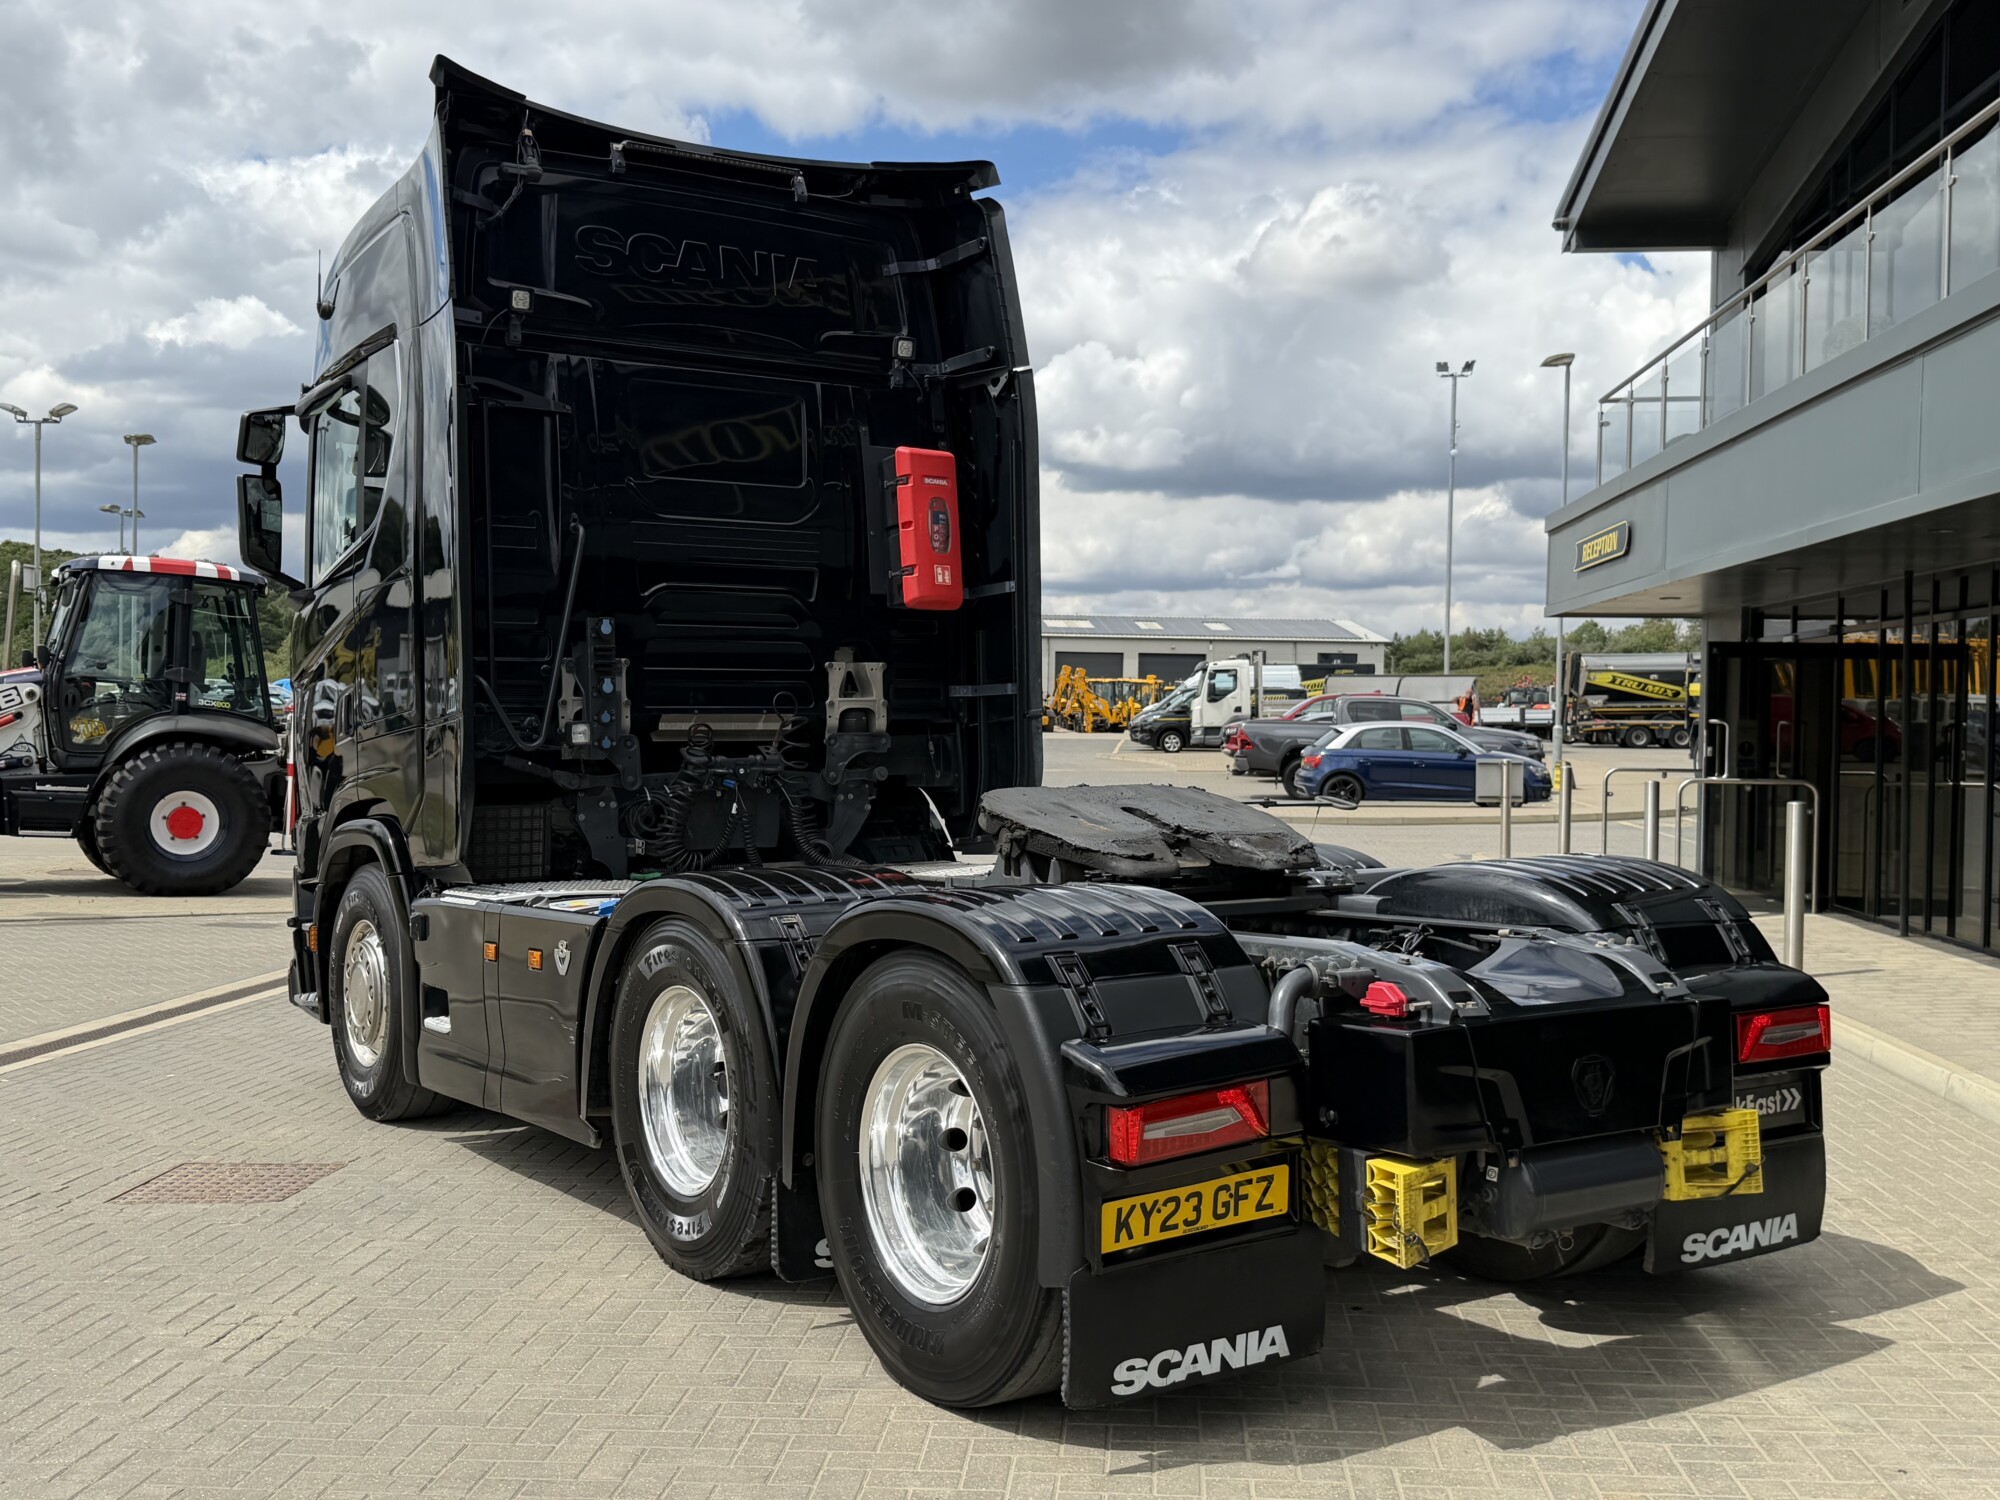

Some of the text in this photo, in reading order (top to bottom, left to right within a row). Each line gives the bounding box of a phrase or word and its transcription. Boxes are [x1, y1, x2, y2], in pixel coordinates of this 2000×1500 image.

[574, 224, 820, 297] SCANIA
[924, 477, 948, 486] SCANIA
[1582, 530, 1619, 563] RECEPTION
[1614, 677, 1676, 698] TRU MIX
[1114, 1174, 1275, 1244] KY23 GFZ
[1680, 1212, 1799, 1264] SCANIA
[839, 1216, 947, 1357] BRIDGESTONE
[1110, 1324, 1291, 1396] SCANIA
